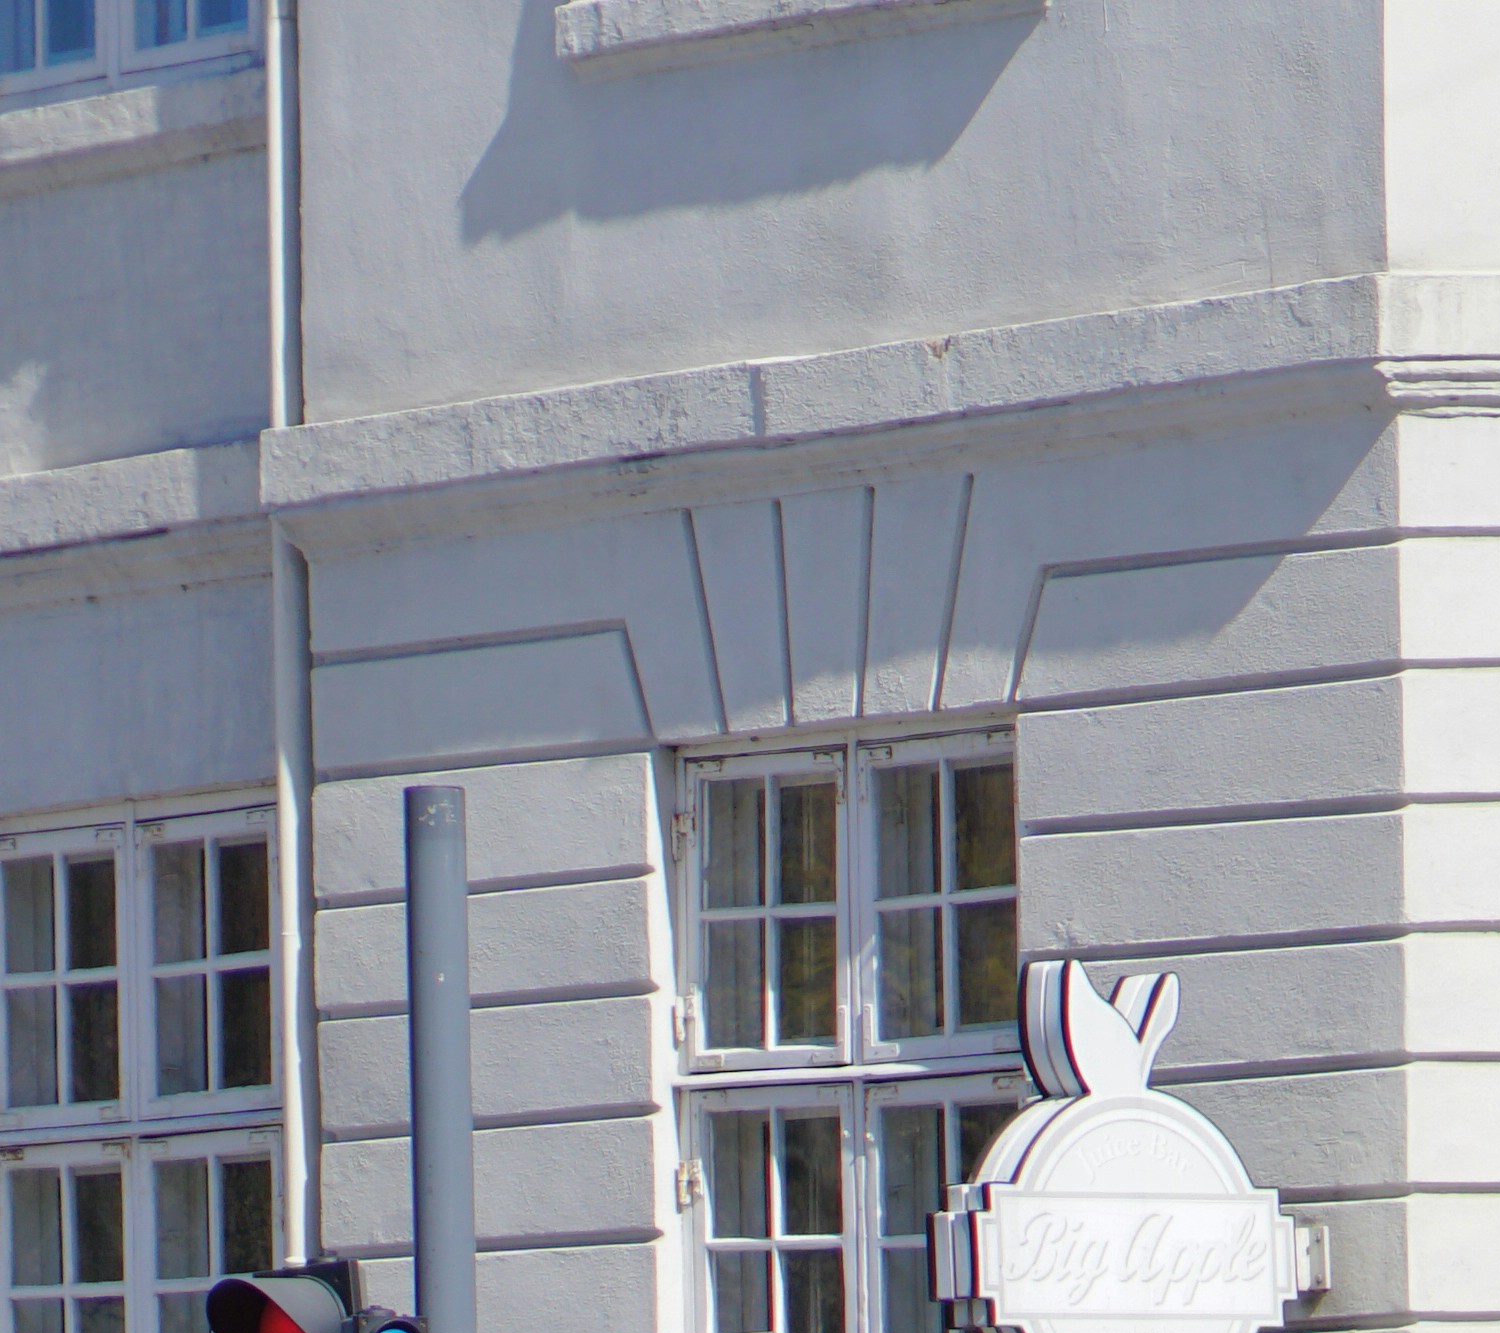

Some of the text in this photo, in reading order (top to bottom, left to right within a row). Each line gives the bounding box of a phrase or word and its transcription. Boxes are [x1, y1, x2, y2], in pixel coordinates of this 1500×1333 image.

[1076, 1129, 1195, 1185] Juice Bar
[1002, 1210, 1267, 1306] Big Apple
